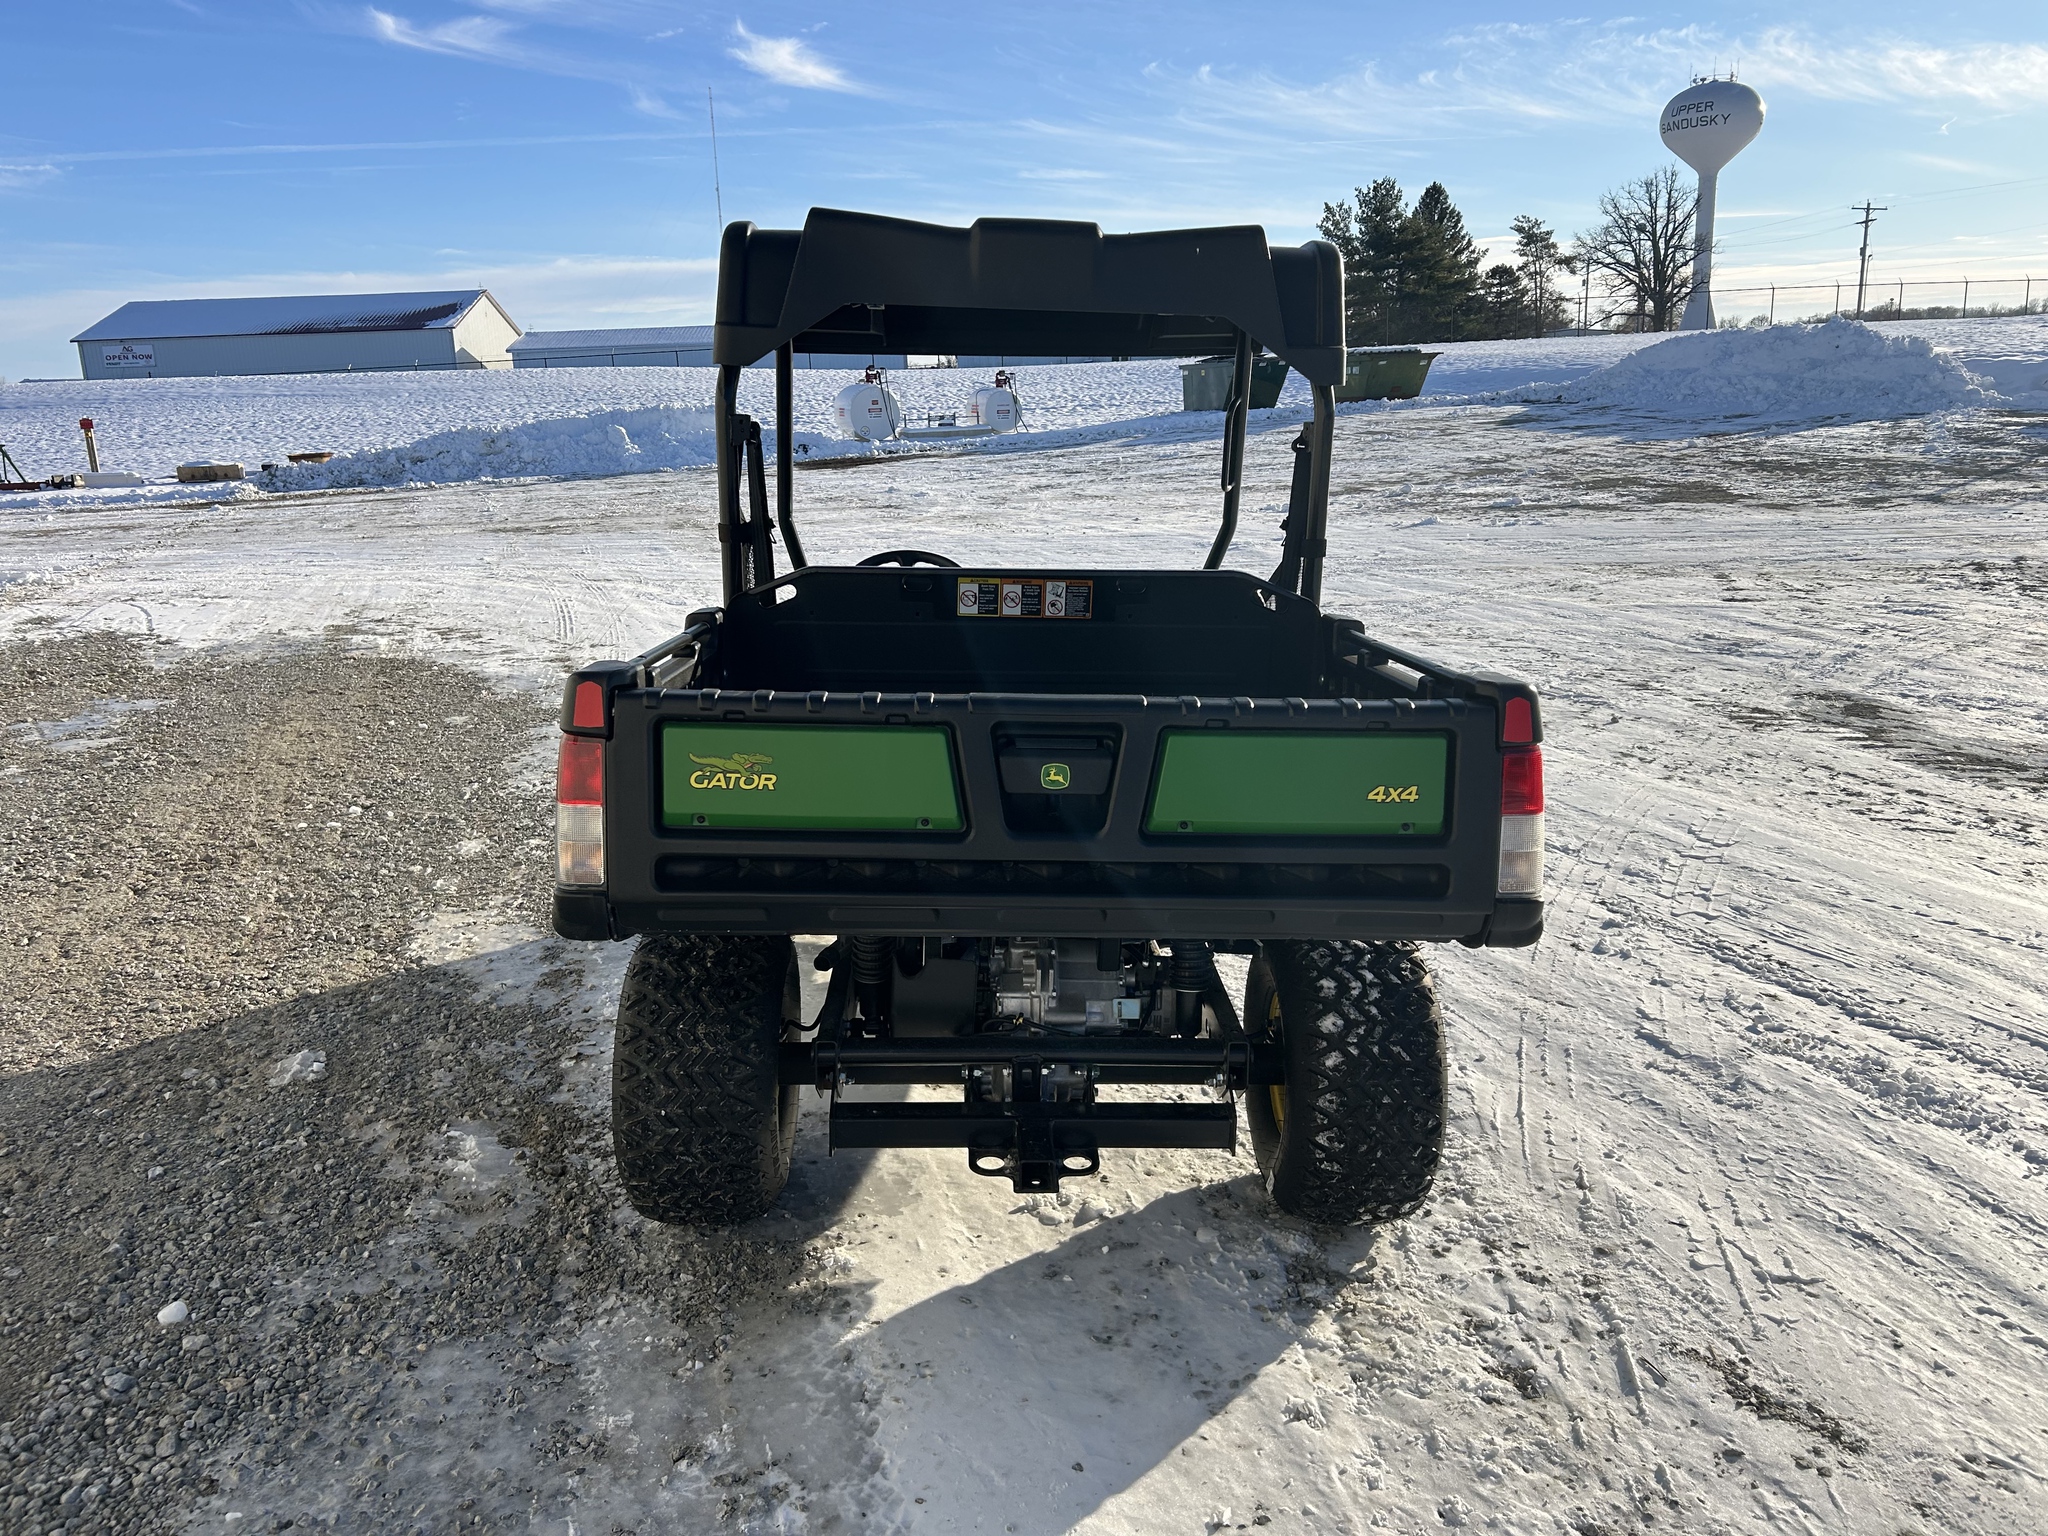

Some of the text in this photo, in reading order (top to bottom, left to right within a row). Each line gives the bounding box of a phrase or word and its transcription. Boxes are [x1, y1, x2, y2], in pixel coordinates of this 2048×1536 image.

[1671, 101, 1714, 118] UPPER
[1661, 113, 1732, 135] SANDUSKY
[689, 770, 778, 790] GATOR
